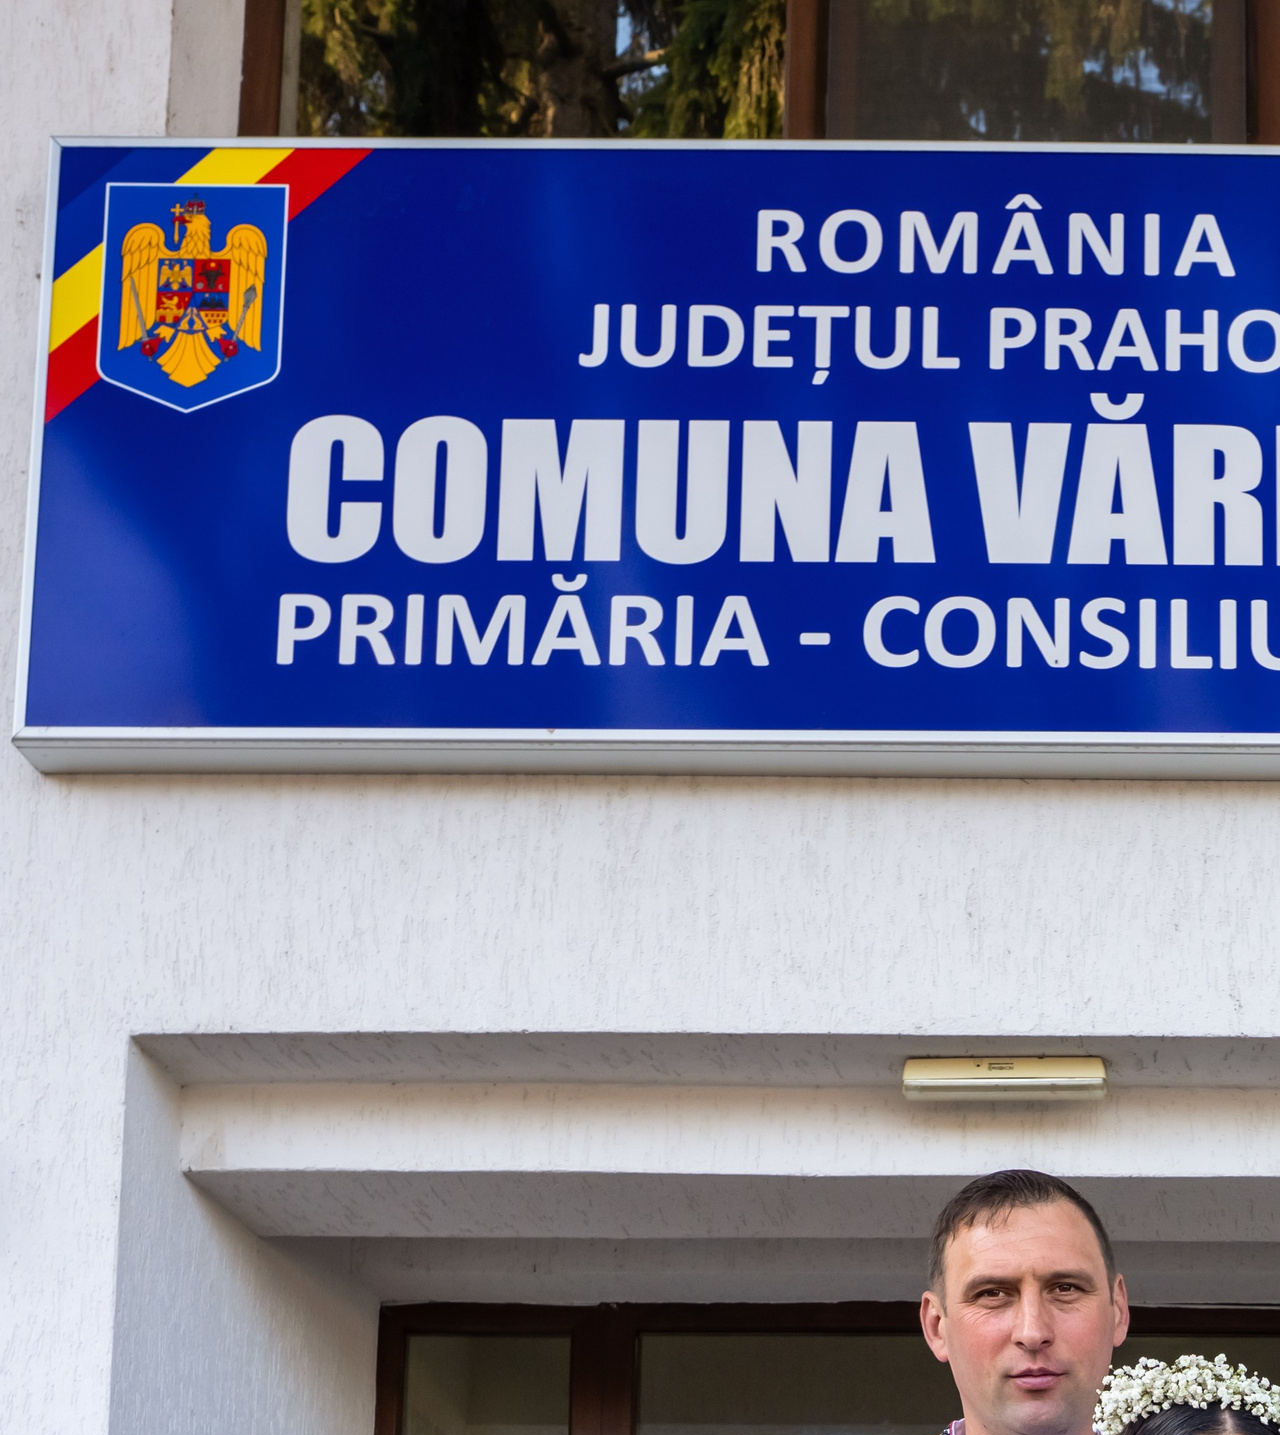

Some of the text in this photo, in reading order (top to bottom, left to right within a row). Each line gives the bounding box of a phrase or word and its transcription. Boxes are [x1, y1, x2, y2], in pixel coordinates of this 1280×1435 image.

[757, 193, 1236, 277] ROMÂNIA
[286, 414, 936, 565] COMUNA
[276, 573, 770, 667] PRIMĂRIA
[799, 632, 831, 646] -
